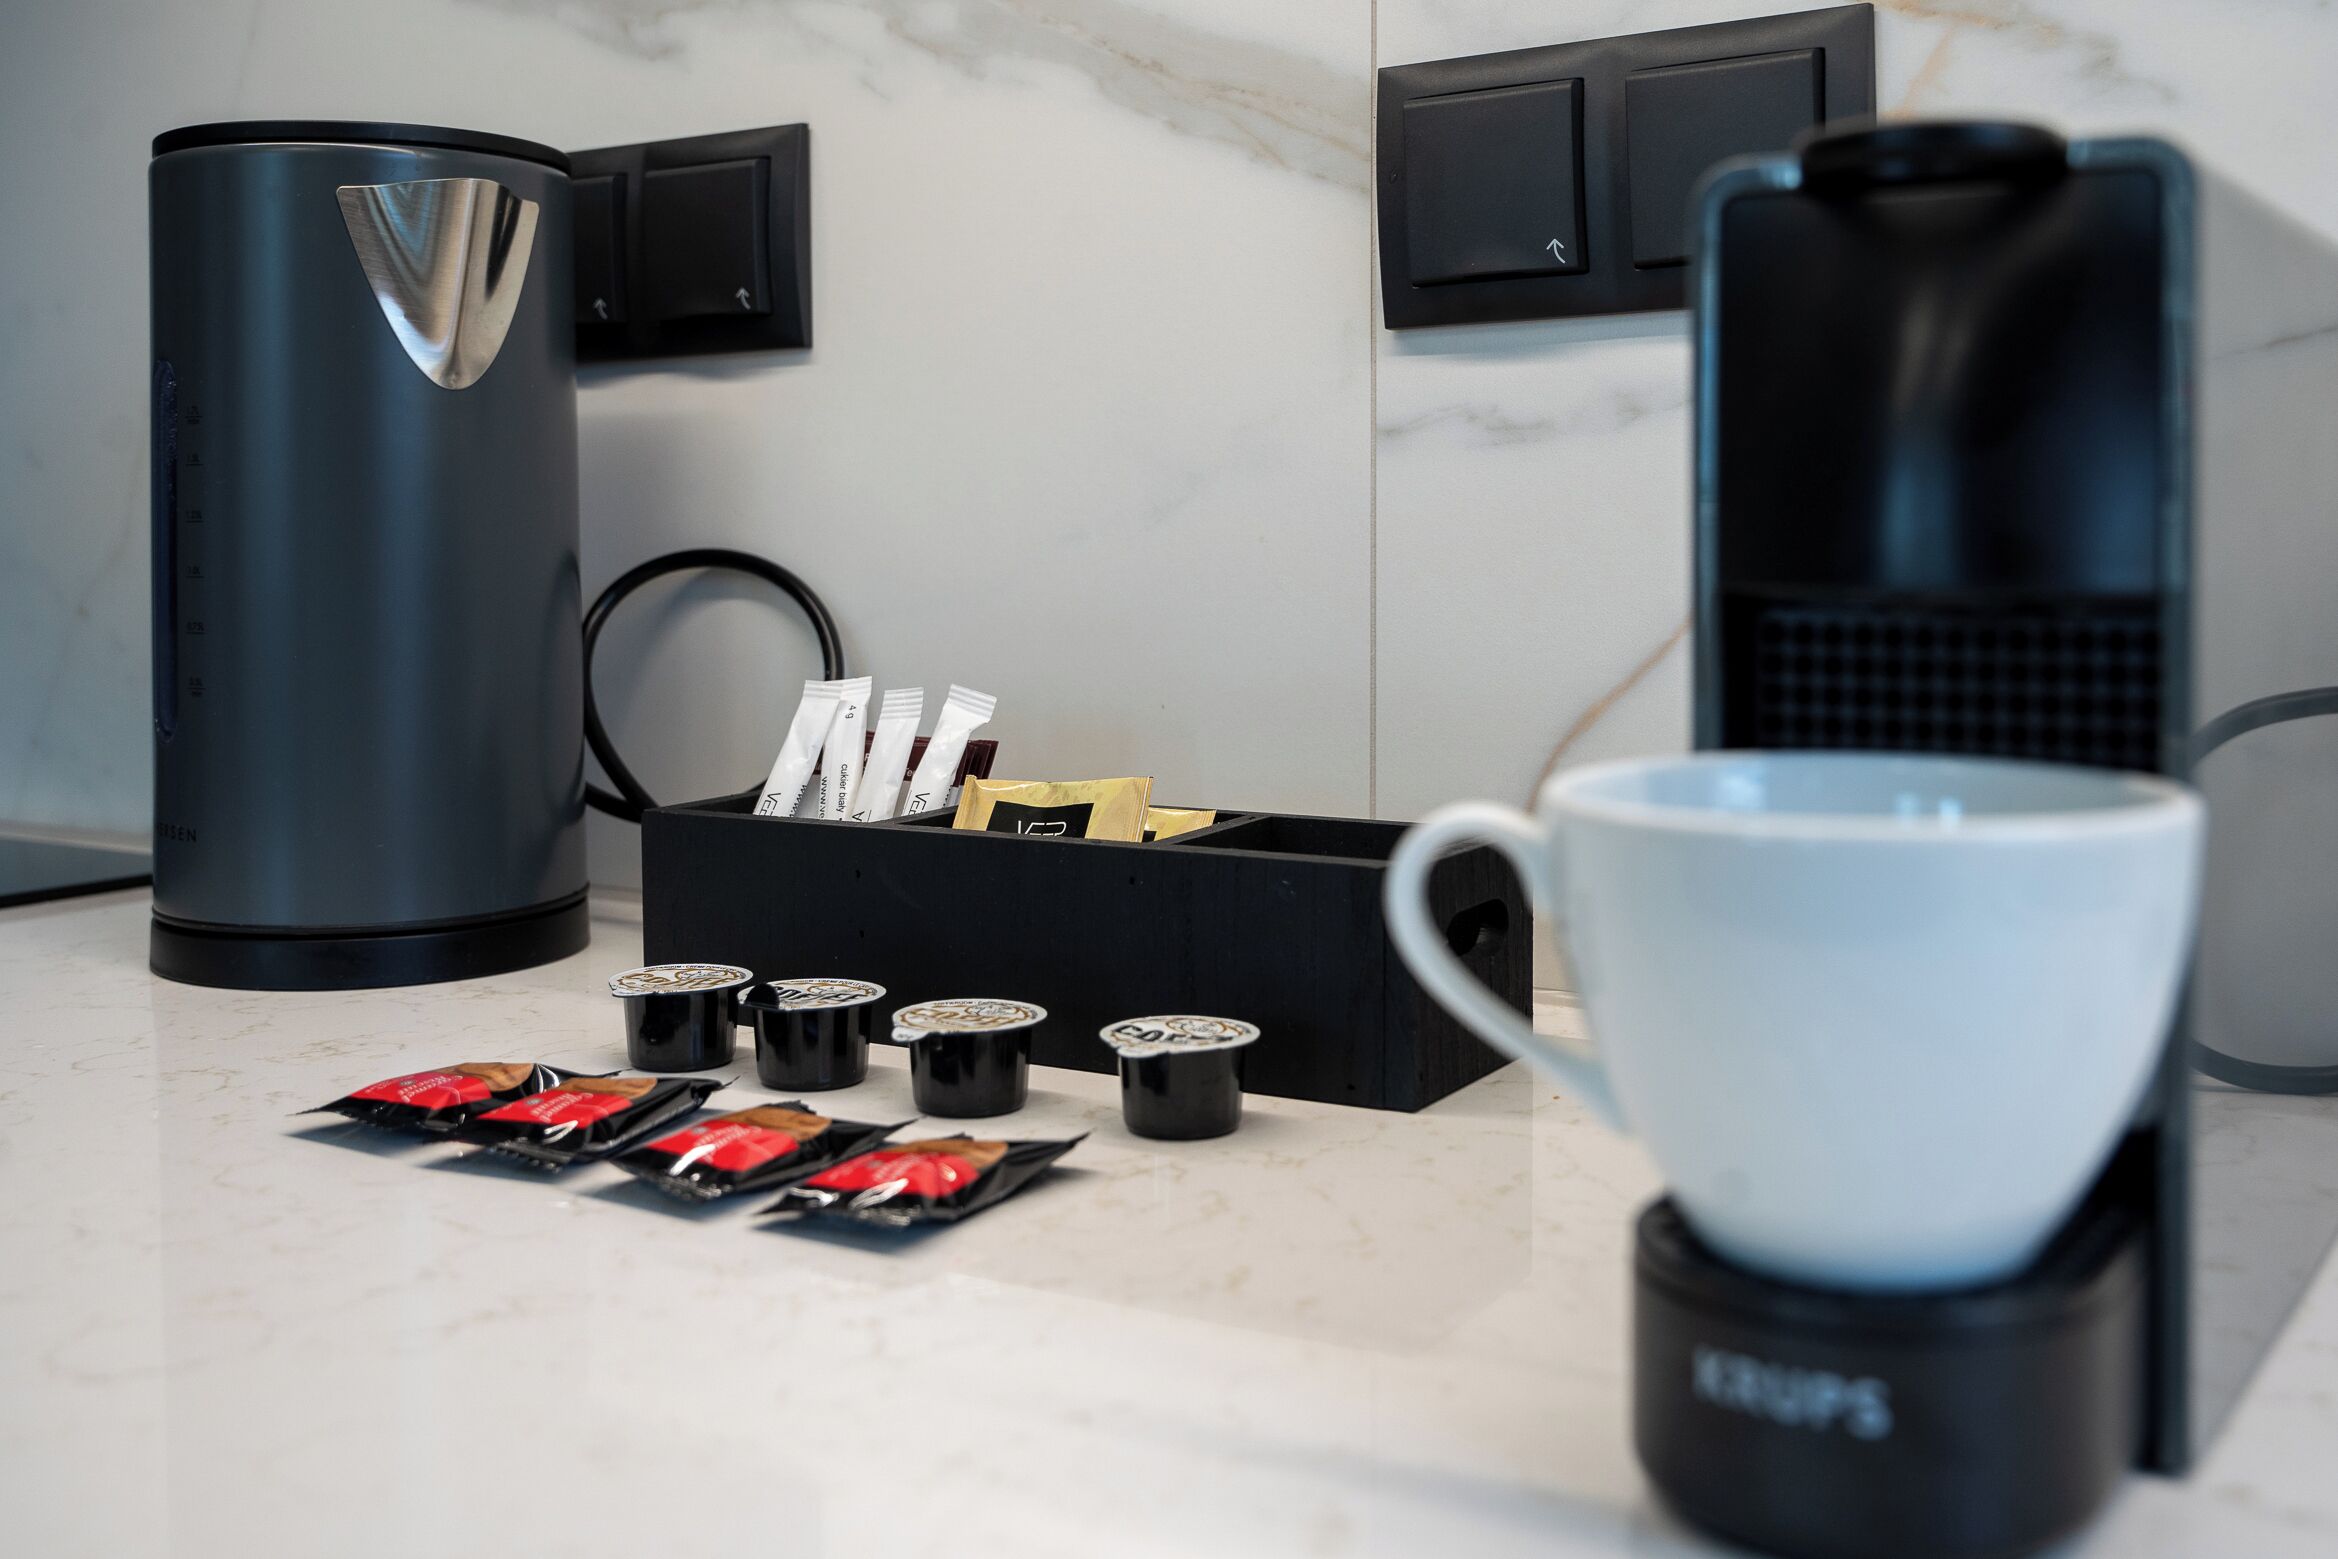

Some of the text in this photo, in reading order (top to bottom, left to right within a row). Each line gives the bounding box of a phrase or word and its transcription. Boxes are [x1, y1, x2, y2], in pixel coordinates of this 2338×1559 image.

[836, 763, 849, 813] cukier biały
[1693, 1345, 1894, 1440] KRUPS
